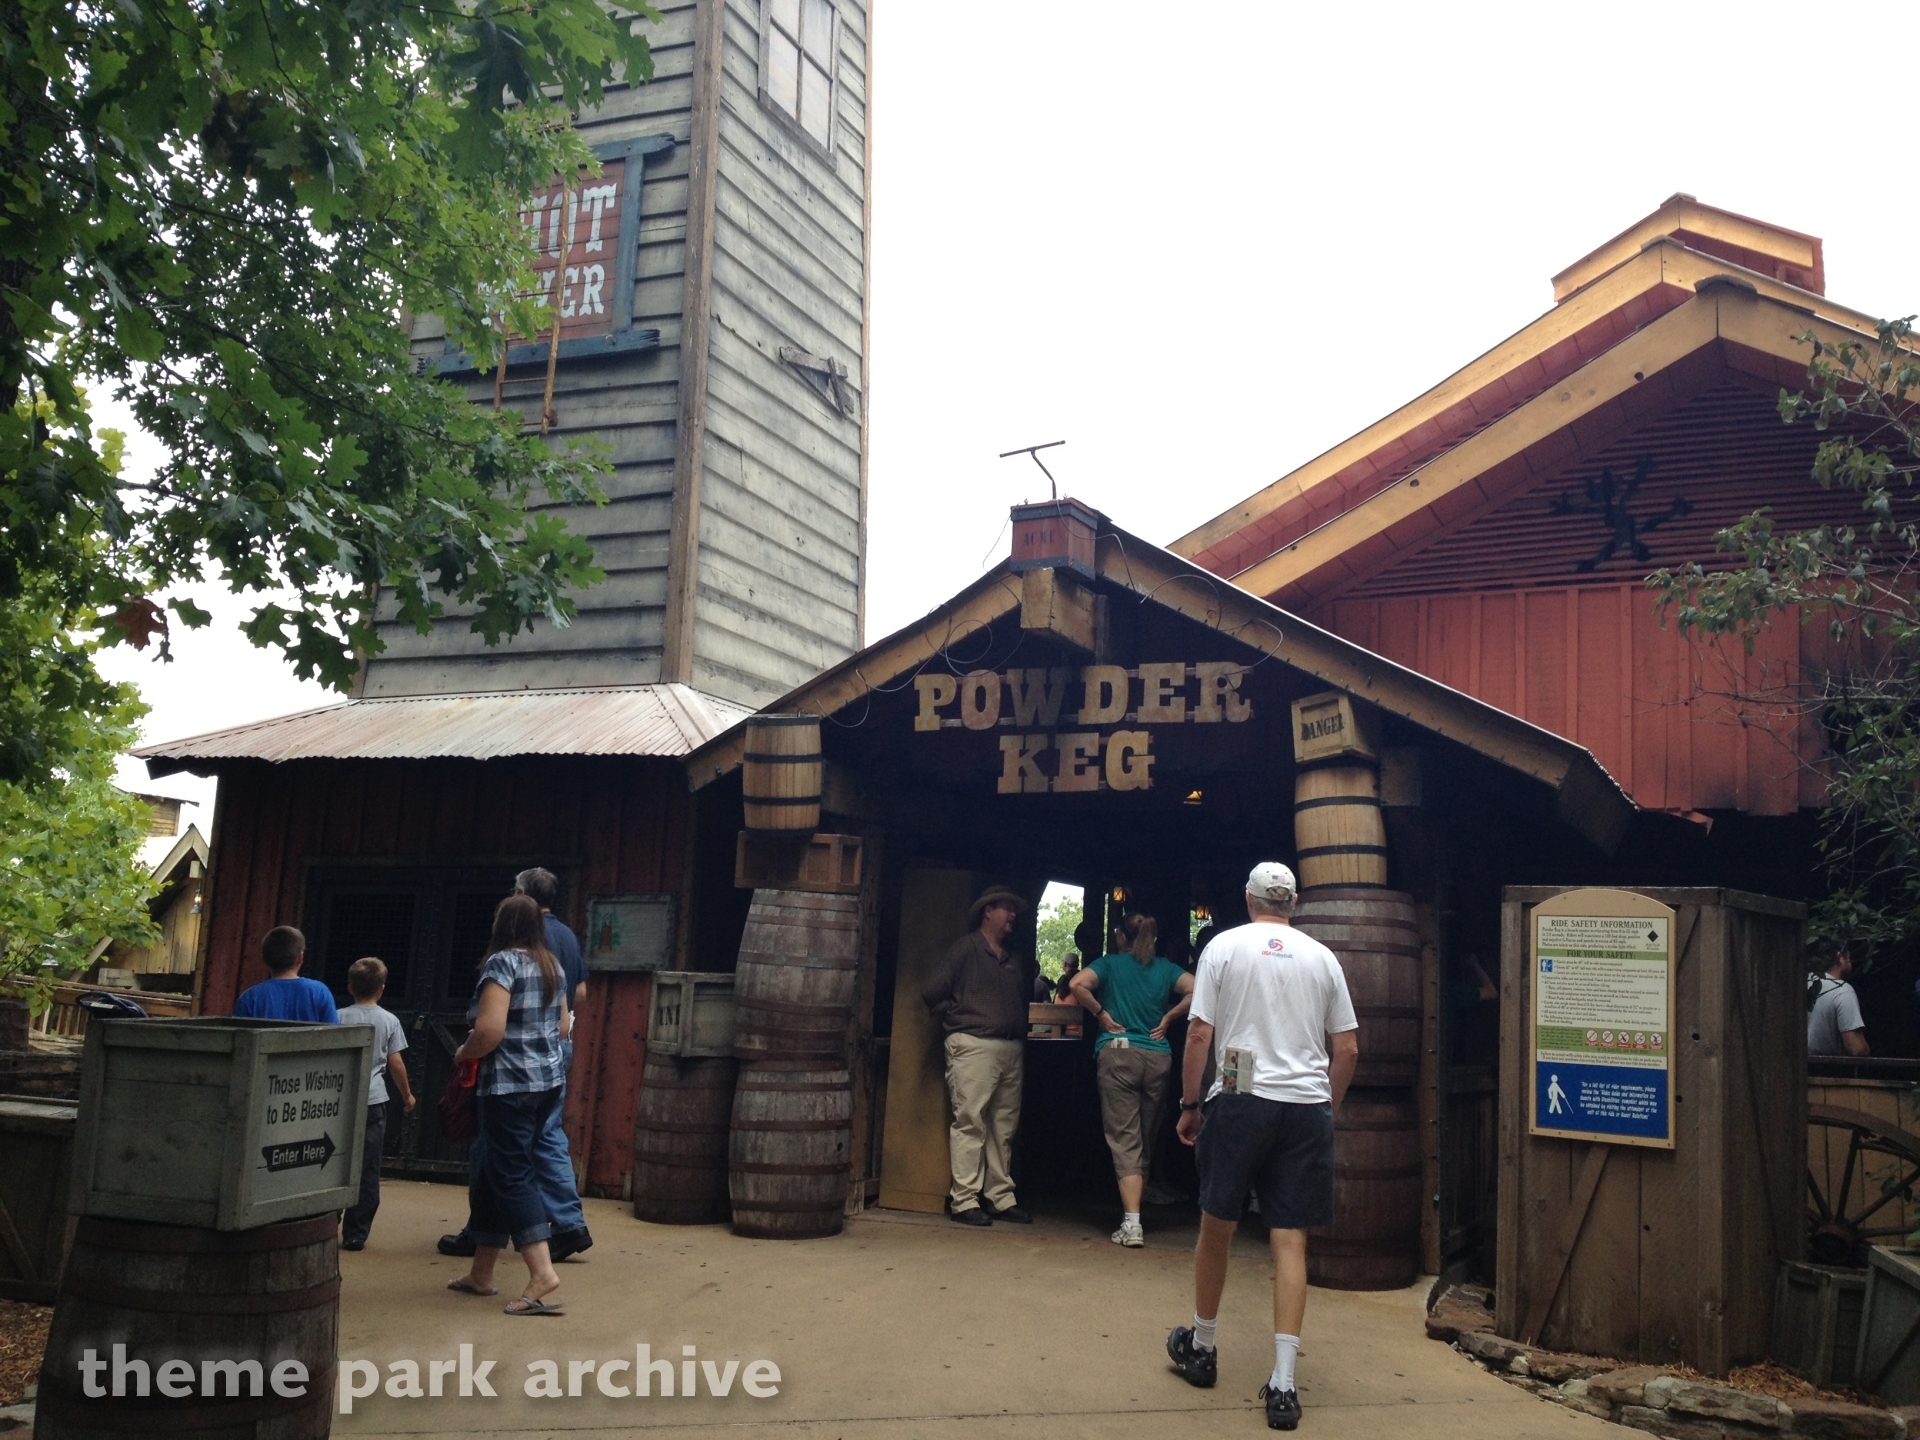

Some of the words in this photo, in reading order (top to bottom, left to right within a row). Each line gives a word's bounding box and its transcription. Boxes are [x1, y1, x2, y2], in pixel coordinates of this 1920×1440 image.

[508, 183, 617, 258] HOT
[914, 661, 1251, 732] POWDER
[997, 730, 1155, 794] KEG
[1551, 919, 1569, 928] RIDE
[1570, 919, 1598, 928] SAFETY
[1600, 920, 1653, 929] INFORMATION
[1566, 949, 1581, 958] FOR
[1583, 950, 1604, 959] YOUR
[268, 1074, 300, 1095] Those
[305, 1069, 344, 1093] Wishing
[266, 1104, 278, 1125] to
[281, 1102, 297, 1123] Be
[300, 1097, 340, 1121] Blasted
[271, 1148, 299, 1165] Enter
[302, 1144, 326, 1161] Here
